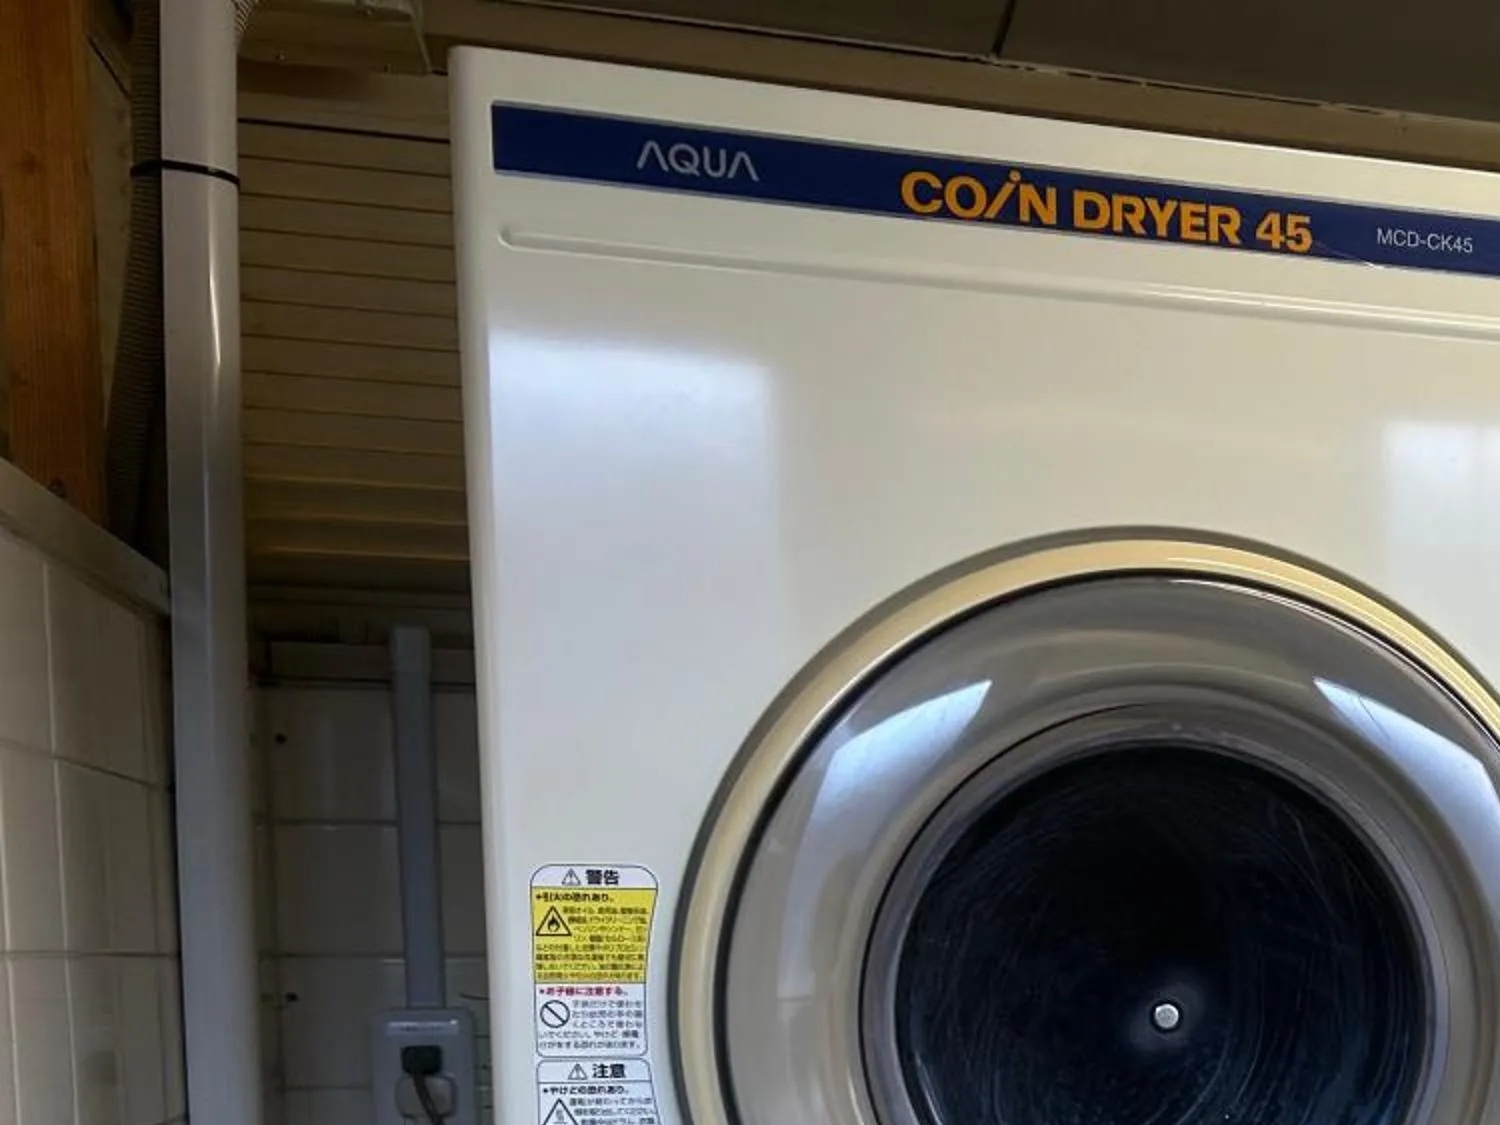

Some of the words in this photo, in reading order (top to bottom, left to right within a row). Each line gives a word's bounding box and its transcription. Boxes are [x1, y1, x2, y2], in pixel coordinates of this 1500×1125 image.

[637, 141, 759, 181] AQUA
[1073, 190, 1241, 245] DRYER
[1255, 213, 1313, 253] 45
[1376, 226, 1474, 254] MCD-CK45
[586, 869, 620, 885] 警告
[592, 1063, 626, 1078] 注意
